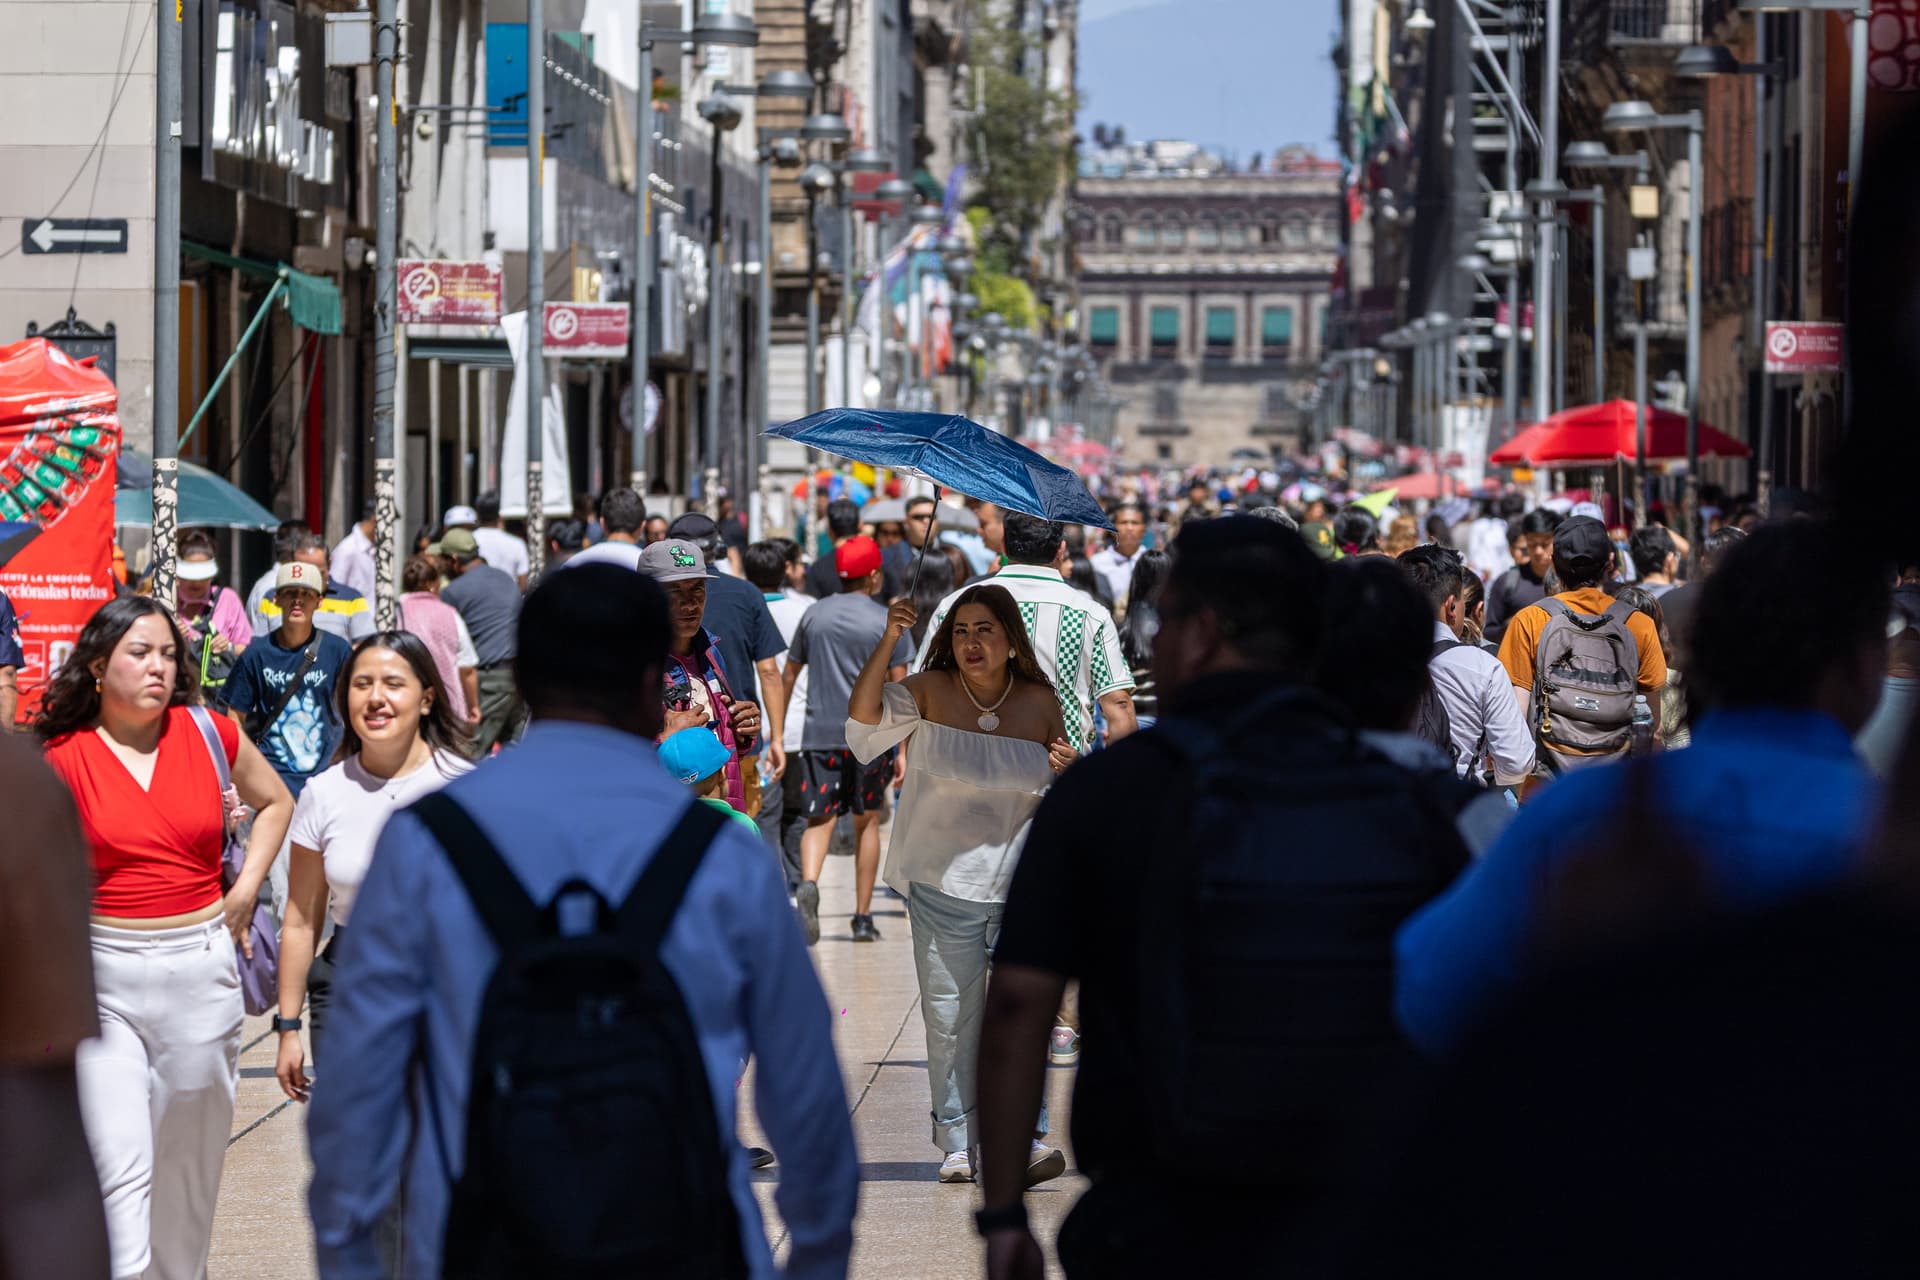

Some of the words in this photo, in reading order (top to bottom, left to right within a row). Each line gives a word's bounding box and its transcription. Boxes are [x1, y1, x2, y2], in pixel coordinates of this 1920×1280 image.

[30, 574, 44, 583] LA
[46, 573, 91, 583] EMOCIÓN
[291, 565, 302, 578] B
[71, 585, 107, 600] todas
